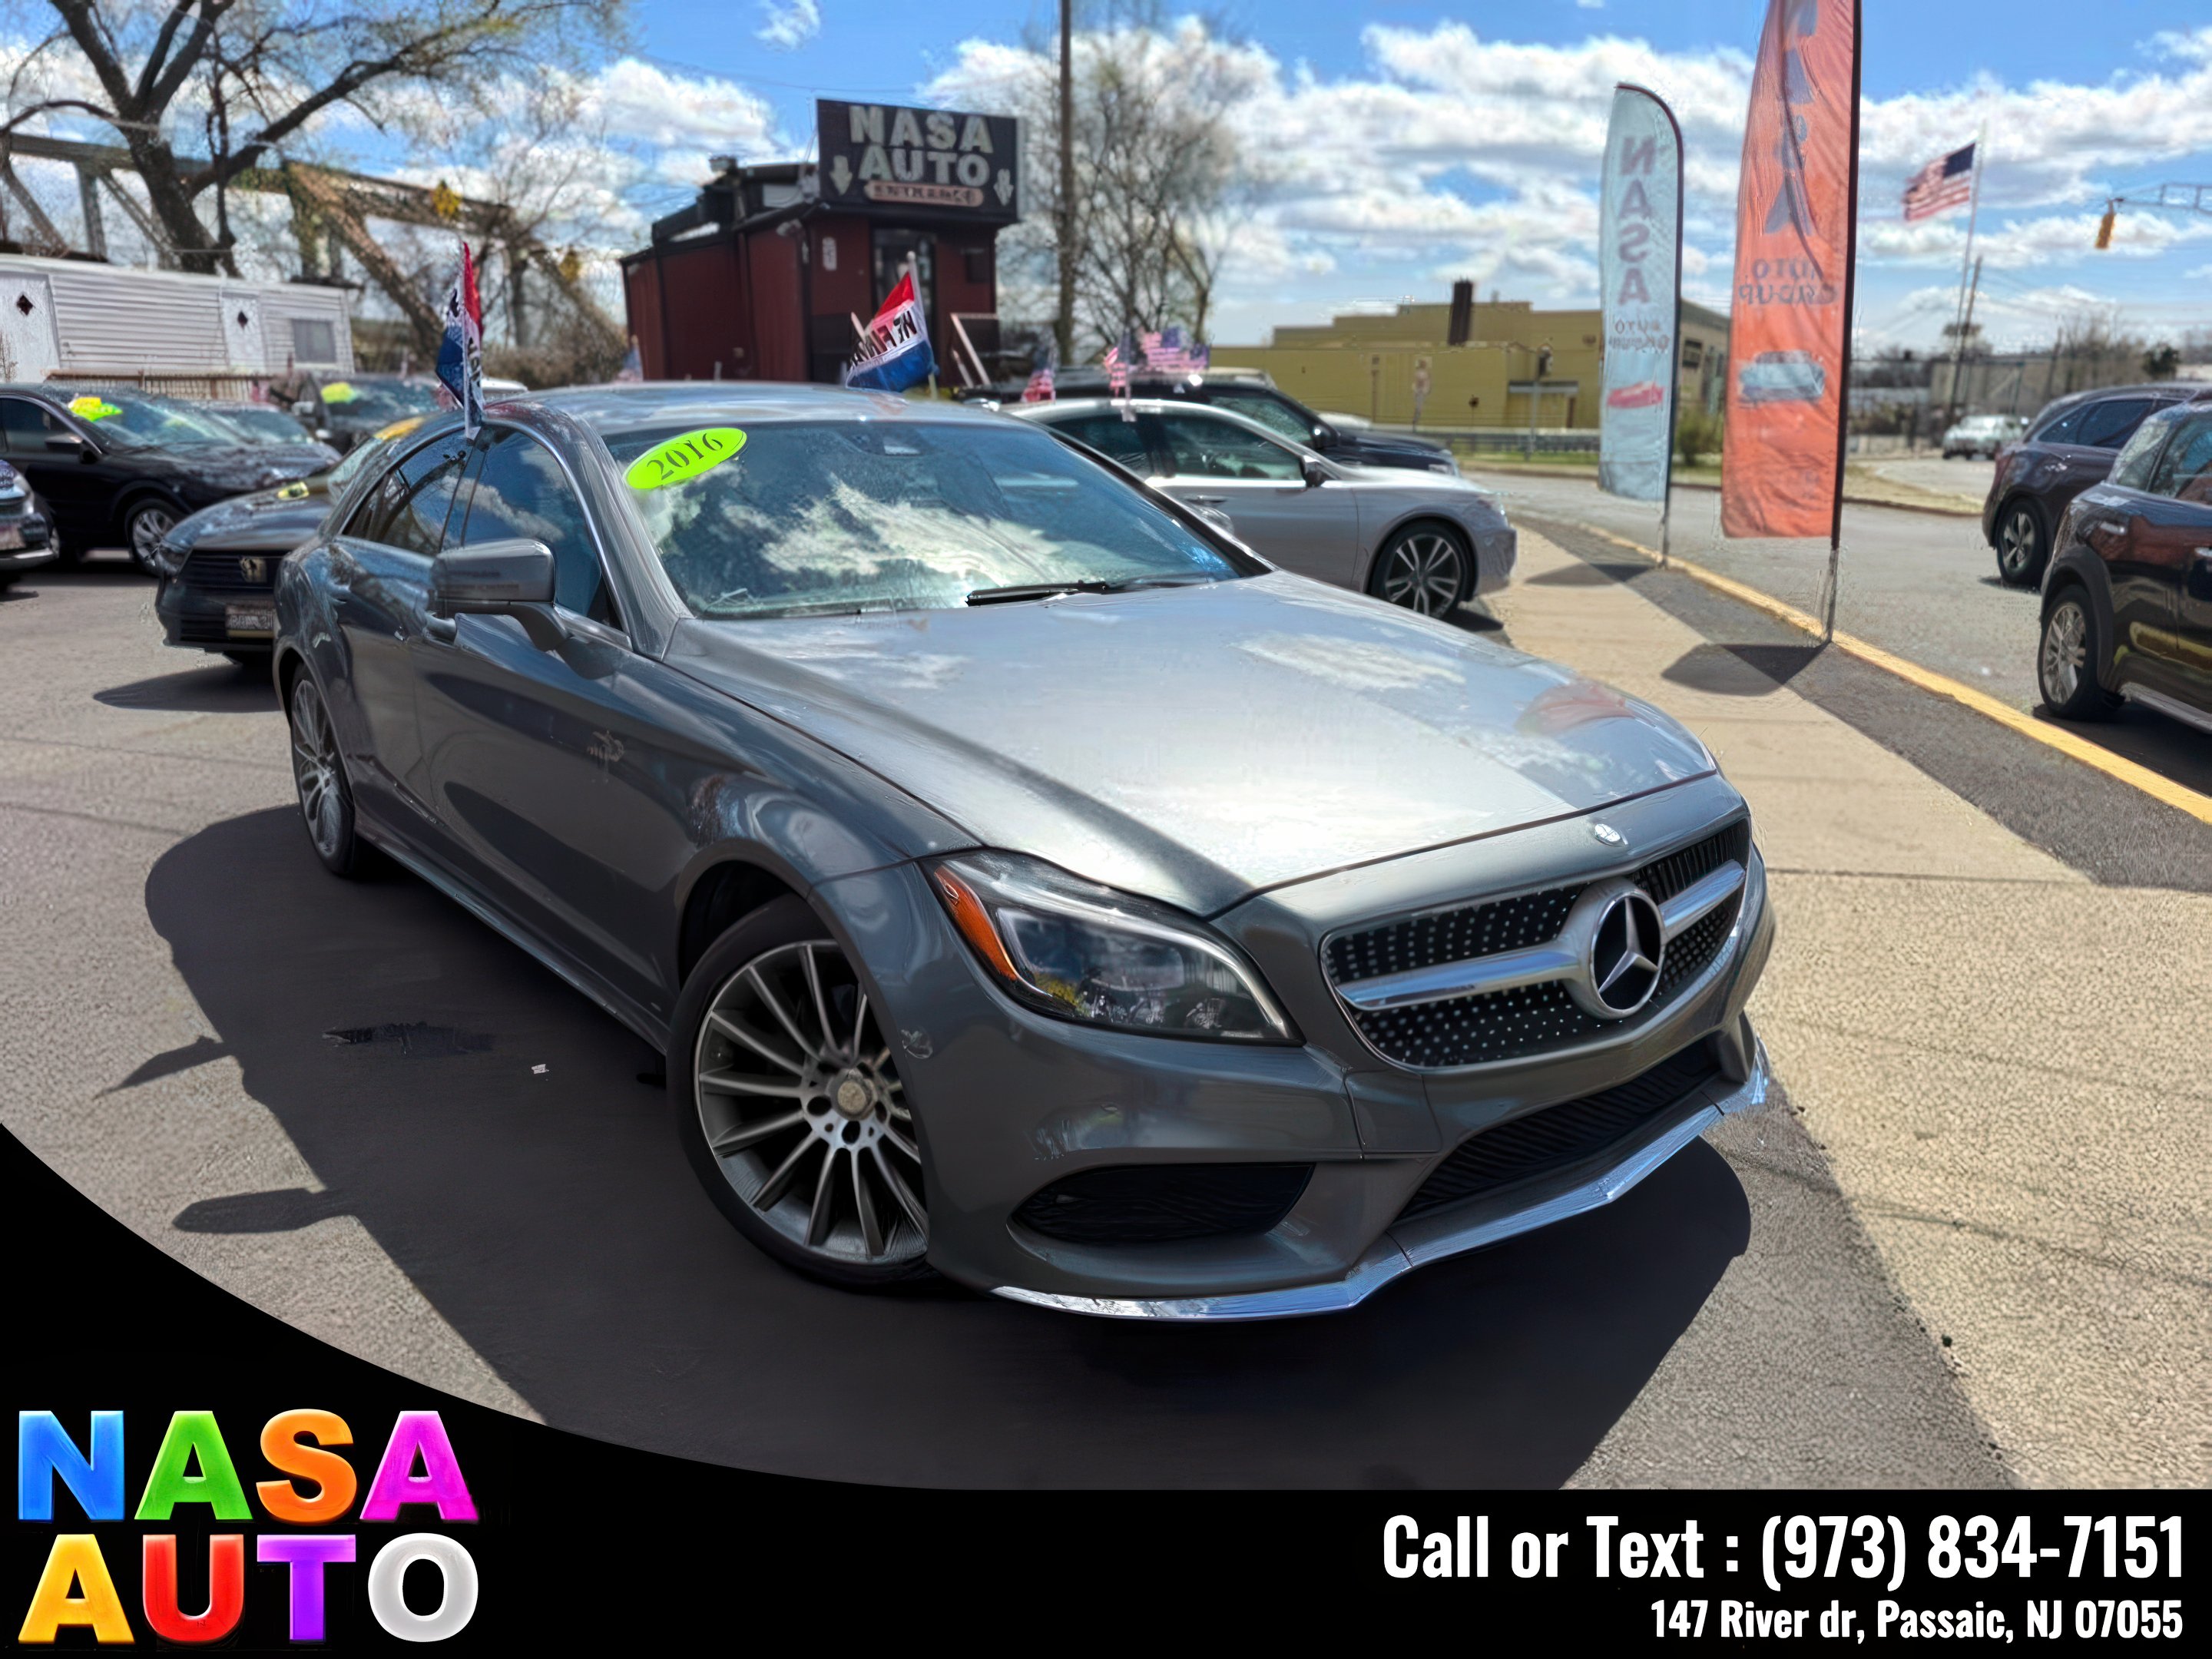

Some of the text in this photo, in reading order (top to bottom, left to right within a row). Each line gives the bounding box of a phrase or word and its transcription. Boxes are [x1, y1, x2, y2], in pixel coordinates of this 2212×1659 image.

[849, 104, 993, 154] NASA
[858, 144, 990, 187] AUTO
[646, 432, 724, 481] 2016
